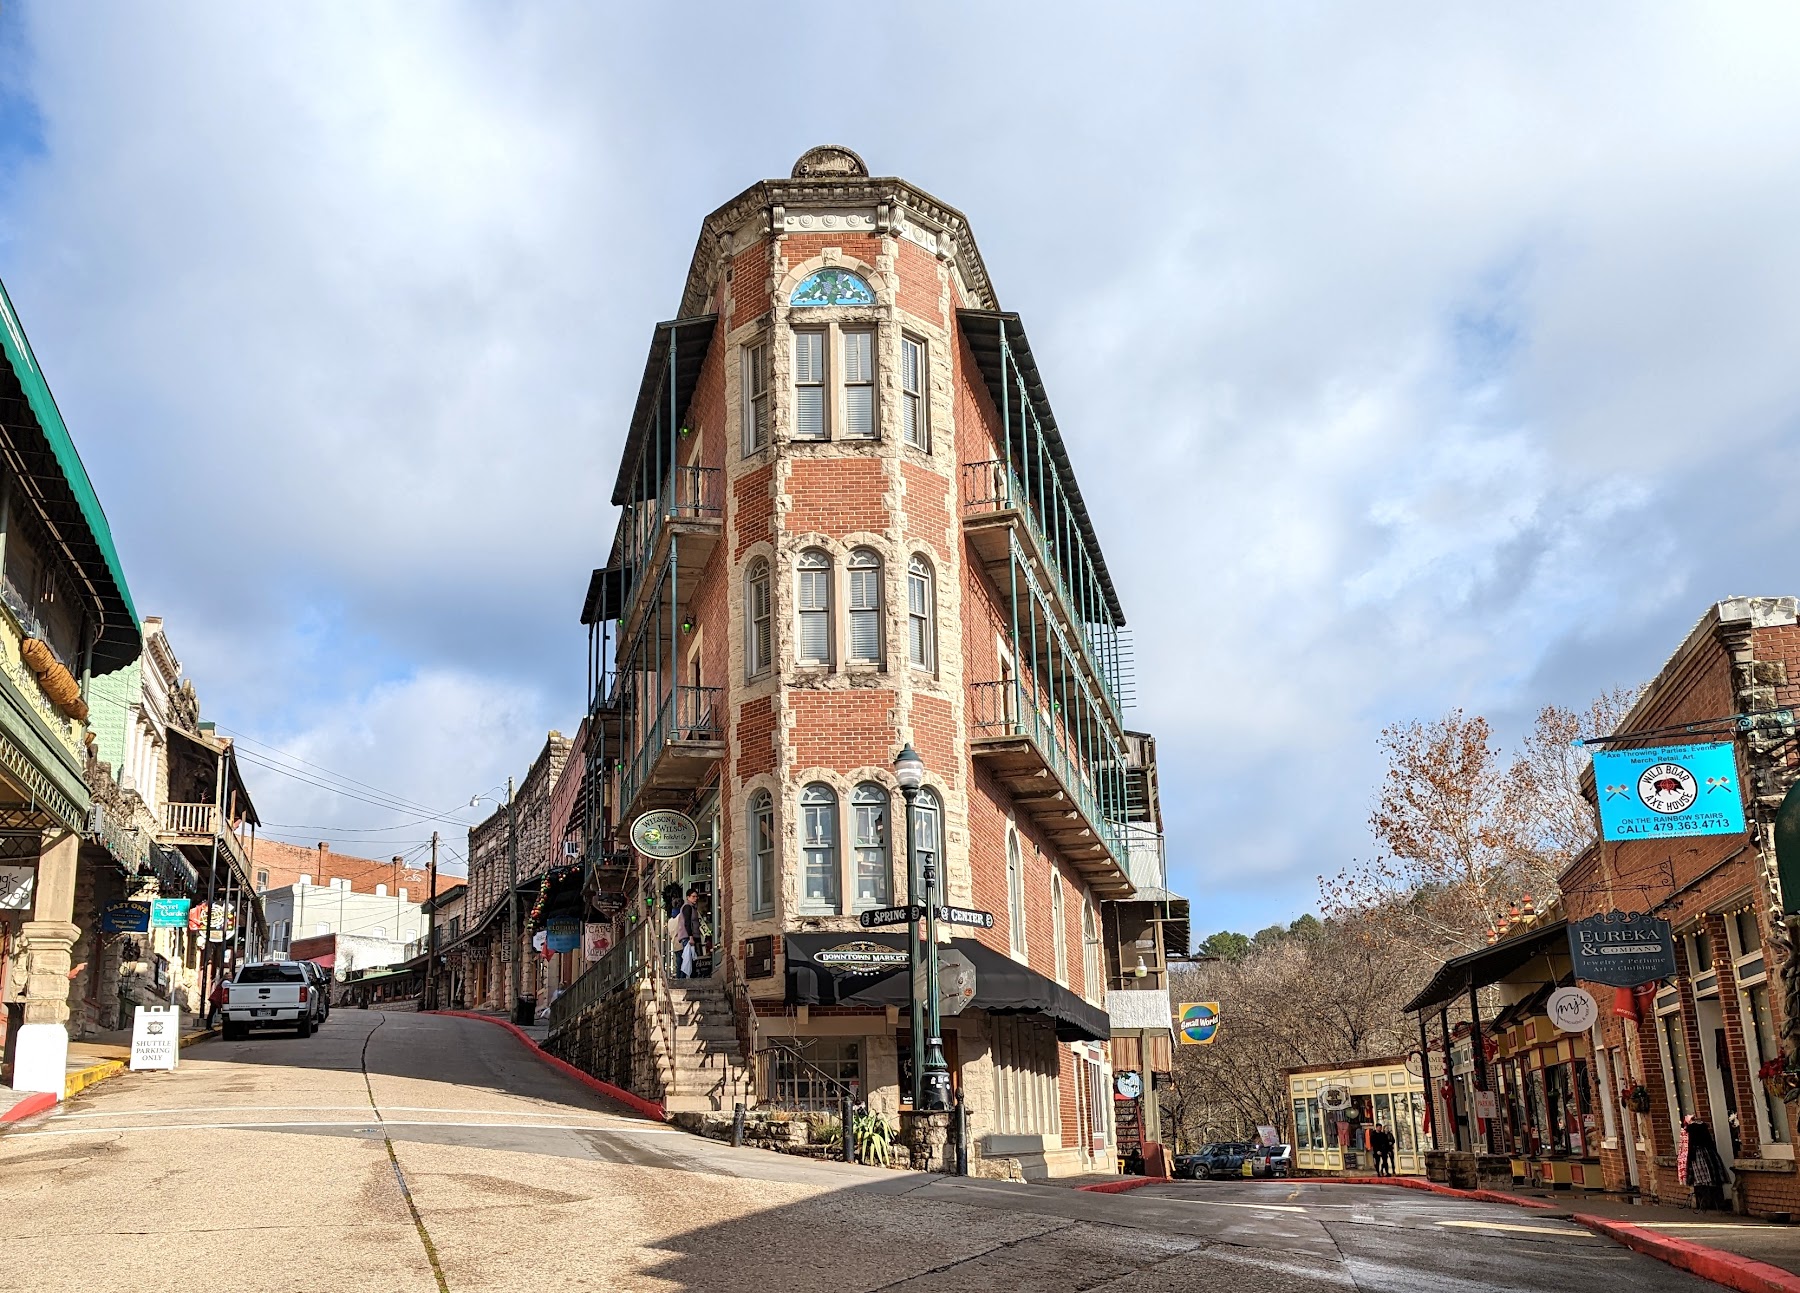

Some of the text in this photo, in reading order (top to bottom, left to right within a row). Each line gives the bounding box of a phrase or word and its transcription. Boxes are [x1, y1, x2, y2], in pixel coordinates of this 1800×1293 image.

[1642, 765, 1690, 784] WILD BOAR
[1645, 791, 1693, 811] AXE HOUSE
[642, 816, 671, 828] WILSON
[1653, 814, 1692, 823] RAINBOW
[658, 824, 688, 833] WILSON
[1617, 819, 1730, 834] CALL 479.363.4713
[106, 902, 149, 914] LAZY ONE
[154, 902, 179, 910] Secret
[160, 909, 188, 917] Garden
[873, 909, 907, 924] SPRING
[950, 909, 984, 926] CENTER
[1579, 929, 1660, 943] EUREKA
[1581, 943, 1659, 956] & COMPANY
[822, 953, 871, 961] DOWNTOWN
[1181, 1015, 1219, 1029] Small World
[1121, 1085, 1140, 1093] World
